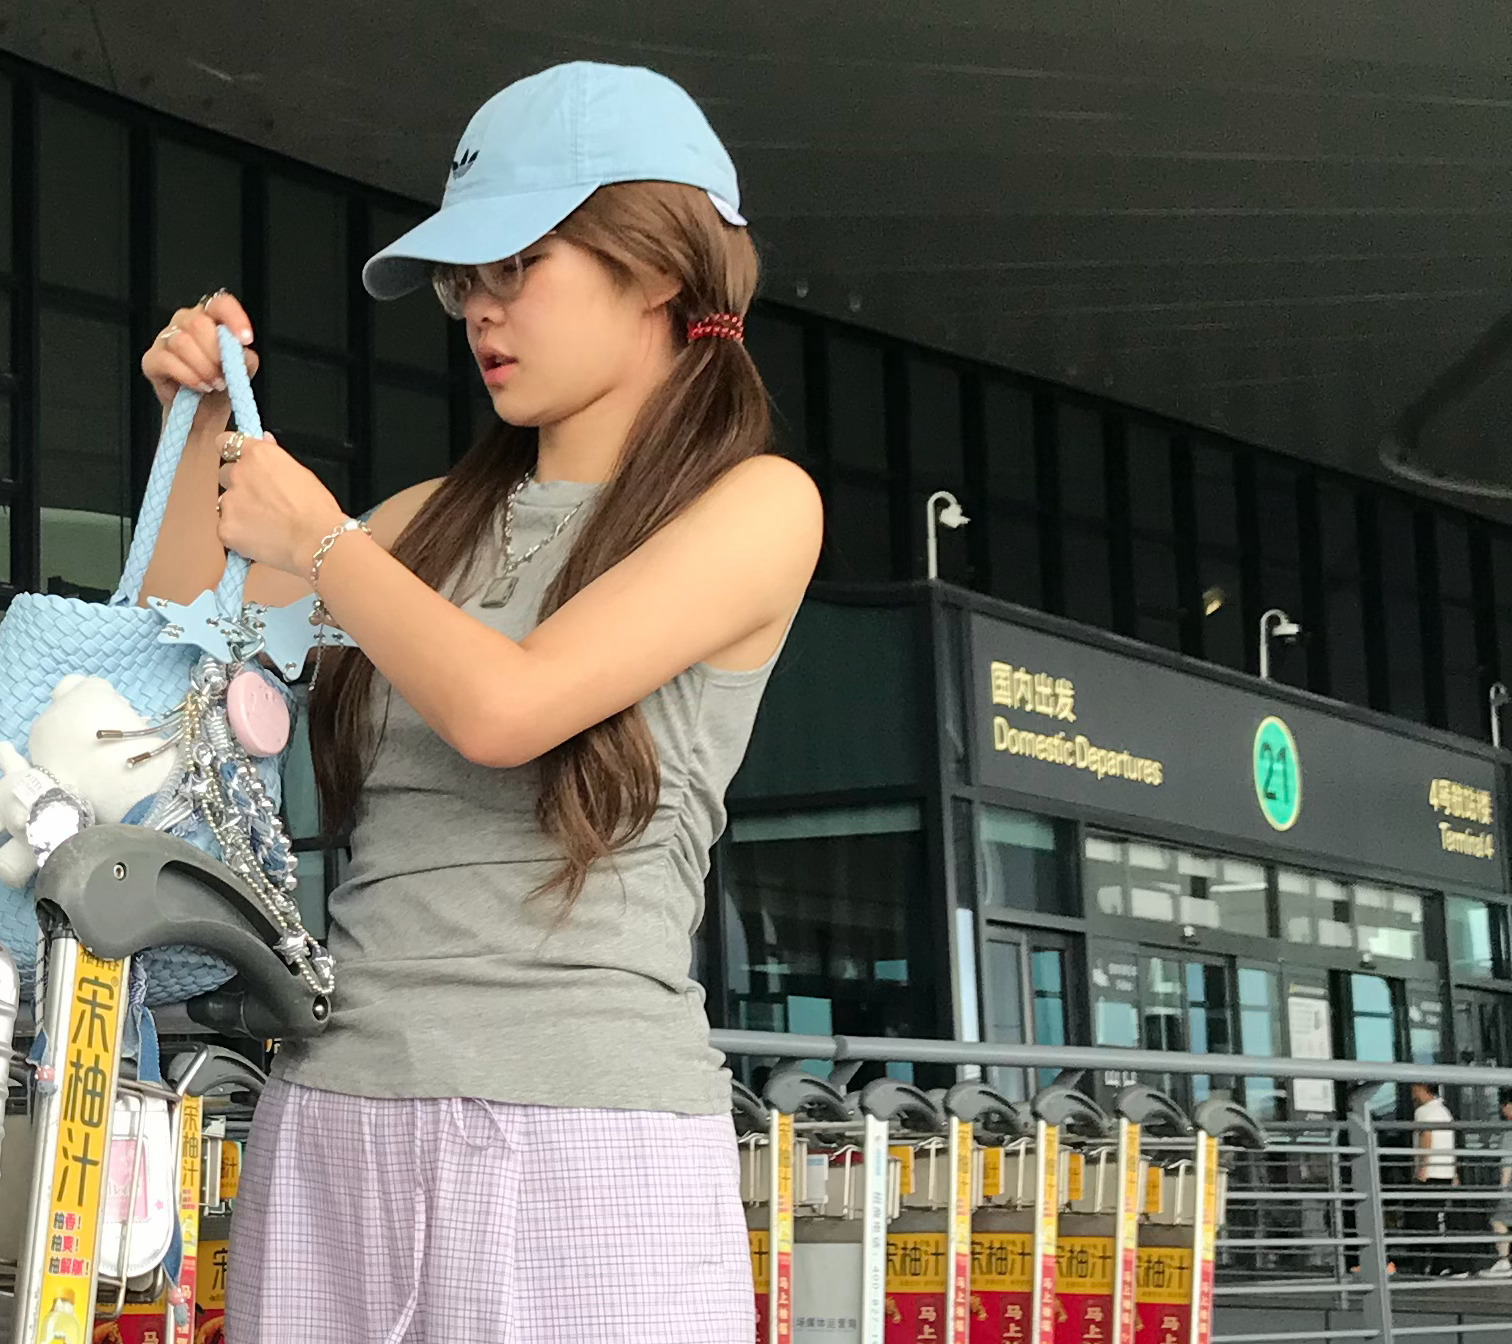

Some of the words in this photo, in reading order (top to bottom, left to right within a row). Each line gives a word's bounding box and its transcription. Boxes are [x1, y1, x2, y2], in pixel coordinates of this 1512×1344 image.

[991, 661, 1076, 722] 国内出发
[993, 716, 1075, 766] Domestic
[1075, 735, 1163, 785] Departures
[1259, 742, 1290, 804] 21
[57, 975, 115, 1207] 宋柚汁
[182, 1105, 199, 1187] 宋柚汁
